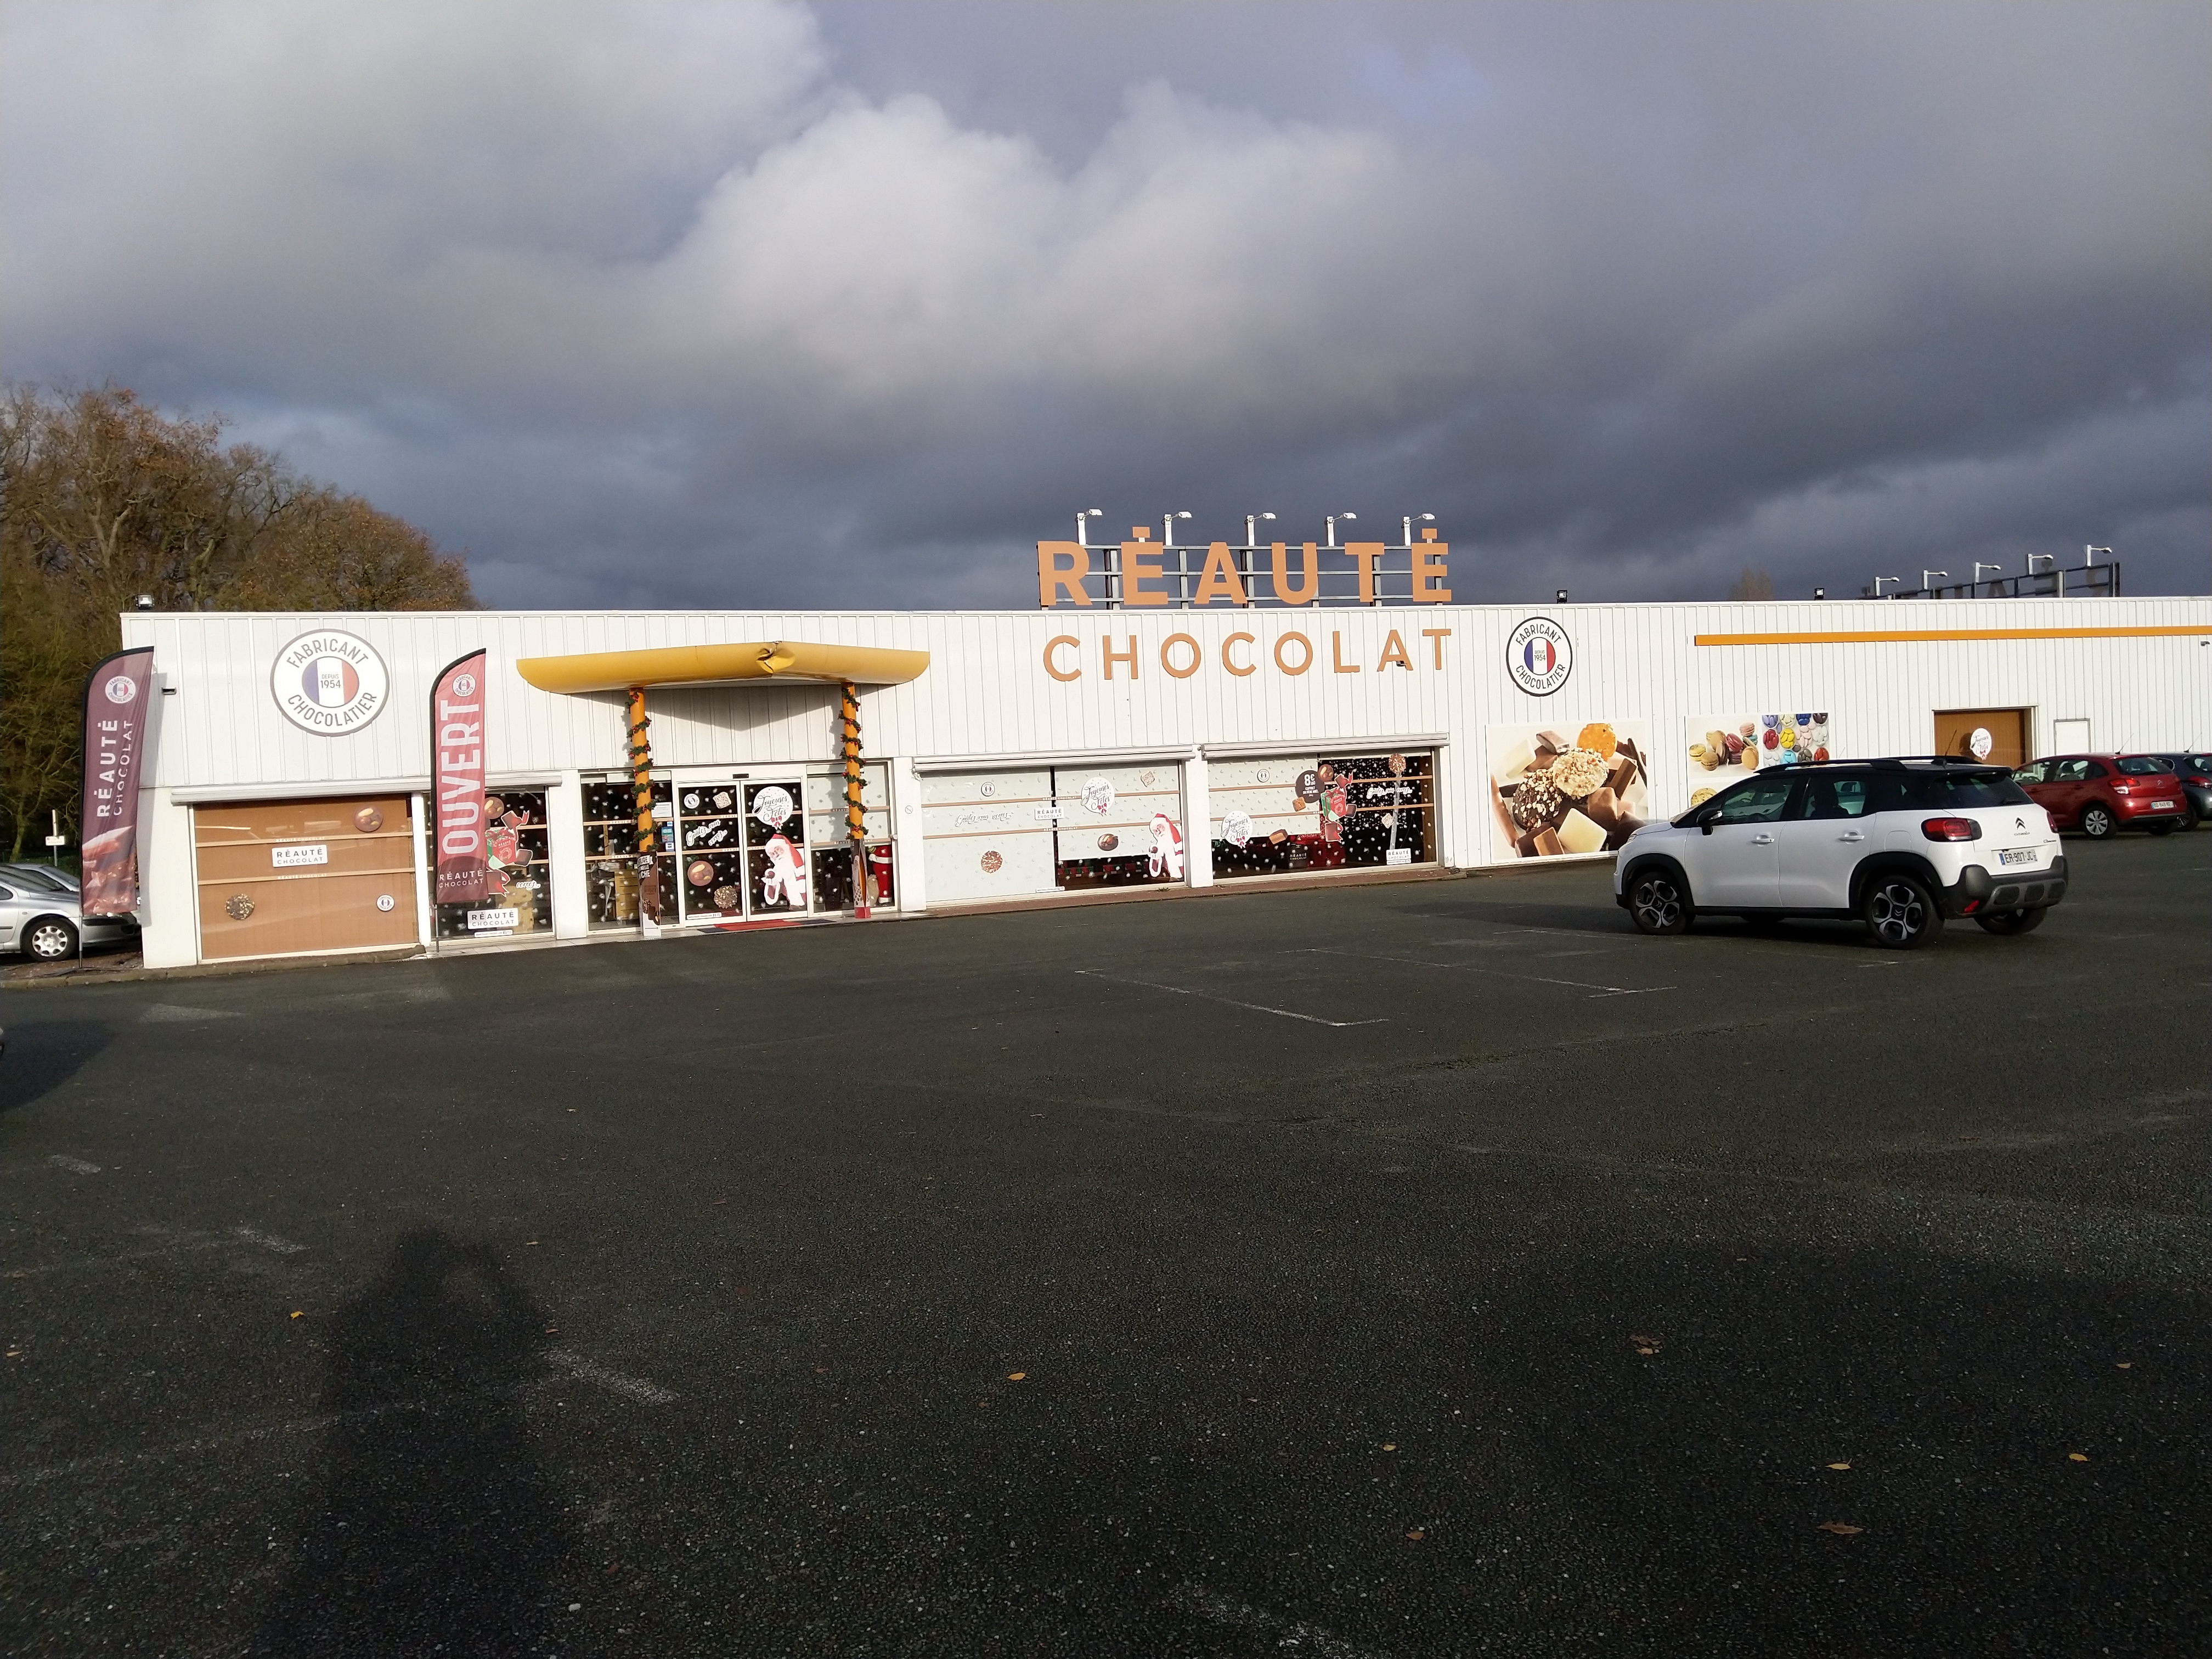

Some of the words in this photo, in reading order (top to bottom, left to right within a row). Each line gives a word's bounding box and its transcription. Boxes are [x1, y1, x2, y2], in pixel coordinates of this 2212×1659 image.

[1037, 527, 1452, 605] RÉAUTÉ
[1516, 624, 1561, 646] FABRICANT
[286, 639, 369, 668] FABRICANT
[1043, 628, 1452, 681] CHOCOLAT
[320, 680, 341, 689] 1954
[1516, 664, 1565, 689] CHOCOLATIER
[288, 692, 377, 726] CHOCOLATIER
[94, 720, 118, 817] RÉAUTÉ
[113, 720, 133, 816] CHOCOLAT
[440, 699, 481, 854] OUVERT
[753, 795, 787, 814] Joyeuses
[276, 848, 323, 858] RÉAUTÉ
[439, 868, 483, 881] RÉAUTÉ
[439, 878, 483, 888] CHOCOLAT
[472, 911, 514, 920] RÉAUTÉ
